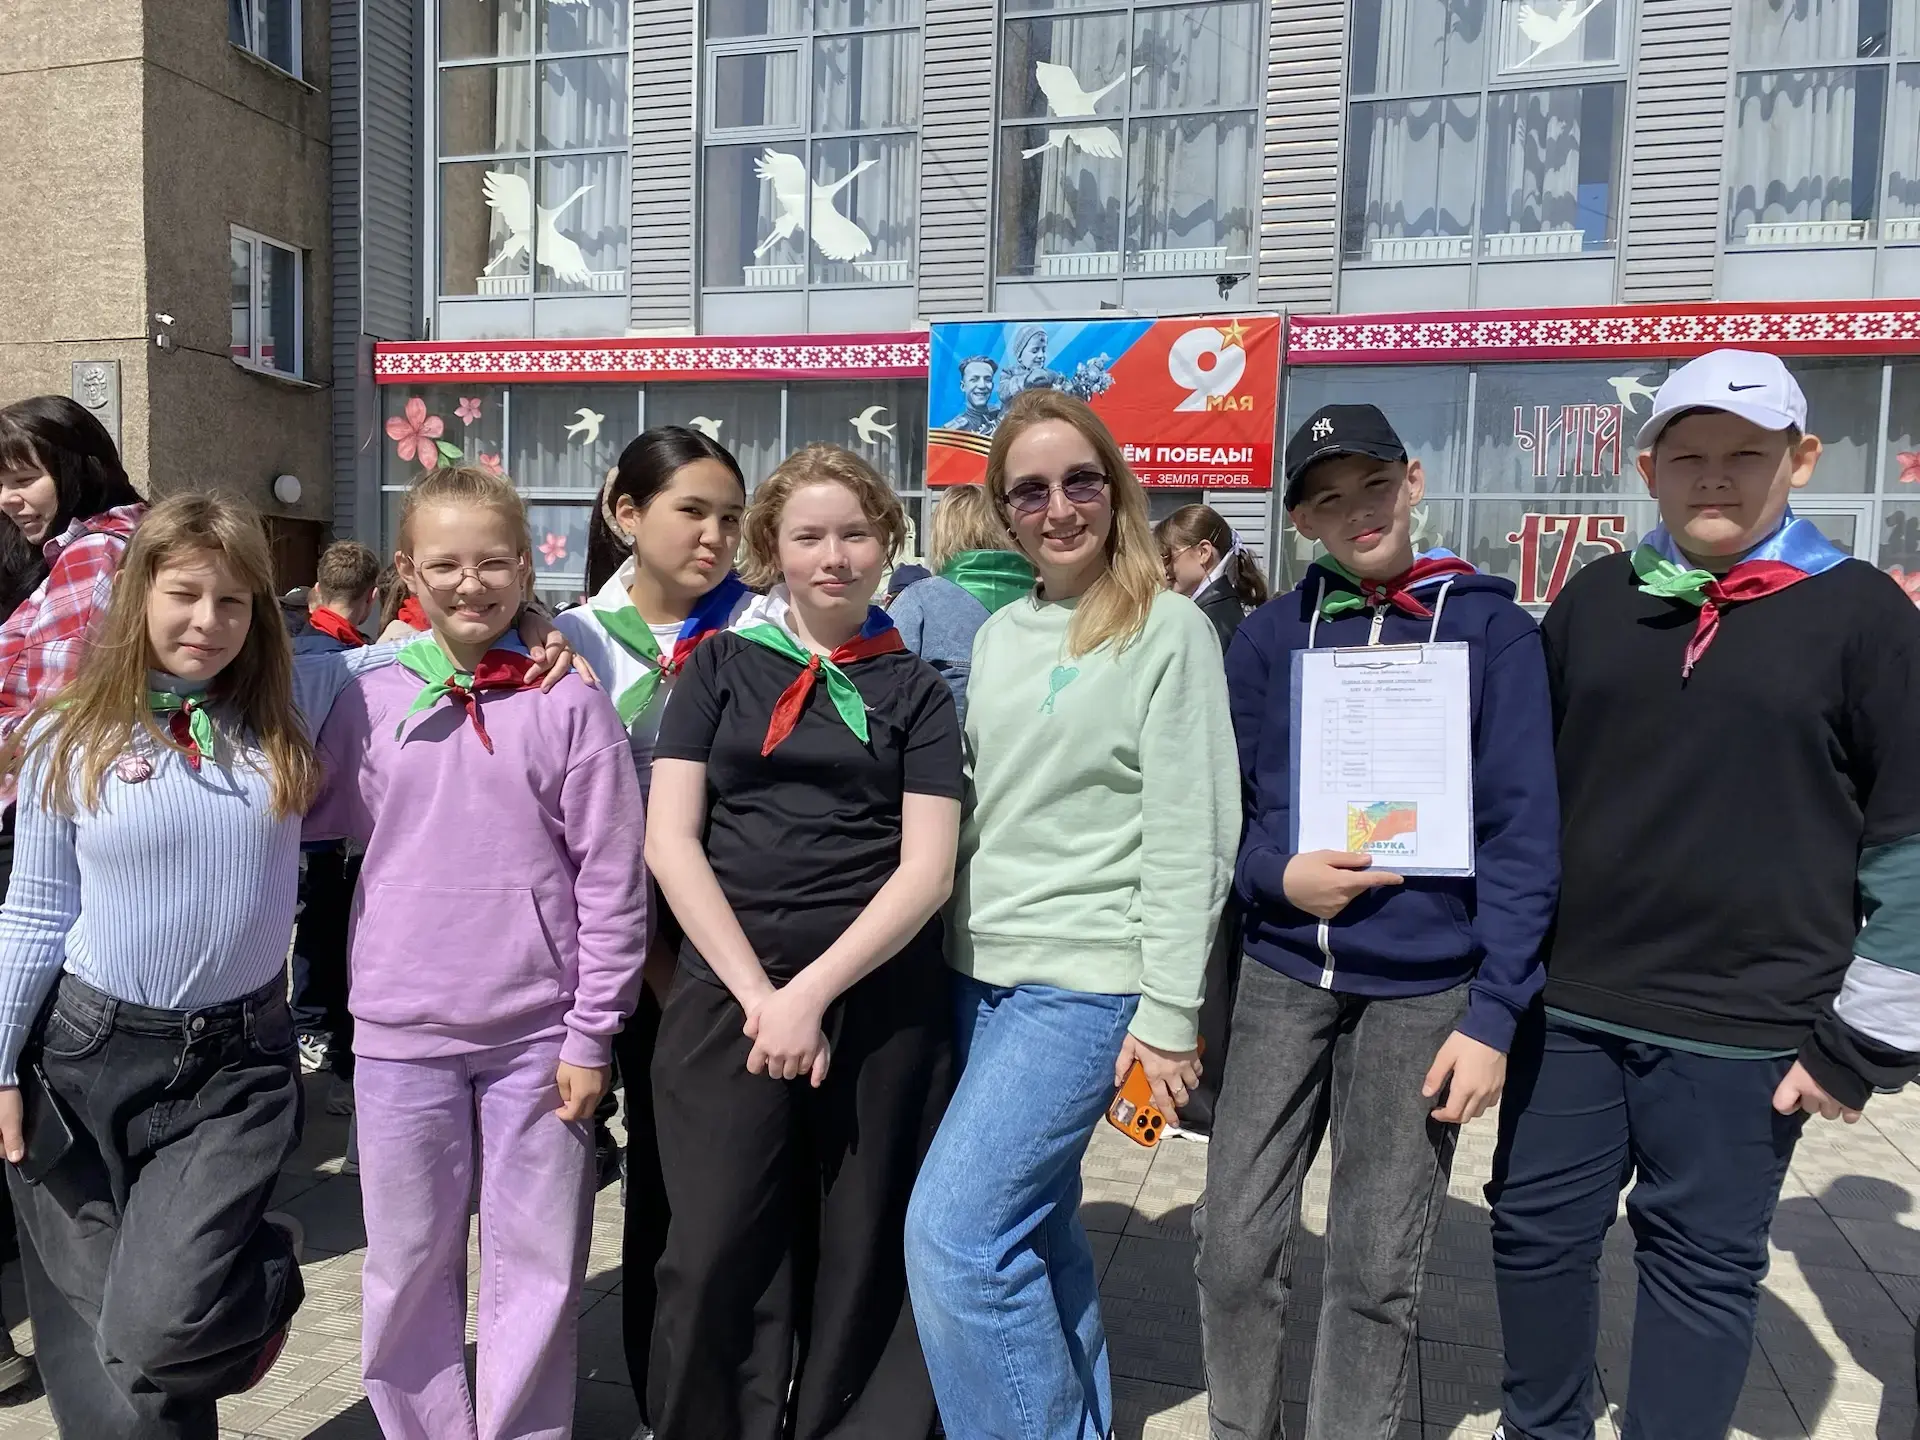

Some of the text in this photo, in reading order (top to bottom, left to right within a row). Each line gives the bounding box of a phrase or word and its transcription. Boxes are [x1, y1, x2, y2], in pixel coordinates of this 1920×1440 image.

[1169, 327, 1254, 412] 9 МАЯ
[1119, 443, 1253, 465] ЁМ ПОБЕДЫ!
[1513, 404, 1624, 477] ЧИТА
[1157, 474, 1198, 484] ЗЕМЛЯ
[1202, 475, 1252, 485] ГЕРОЕВ.
